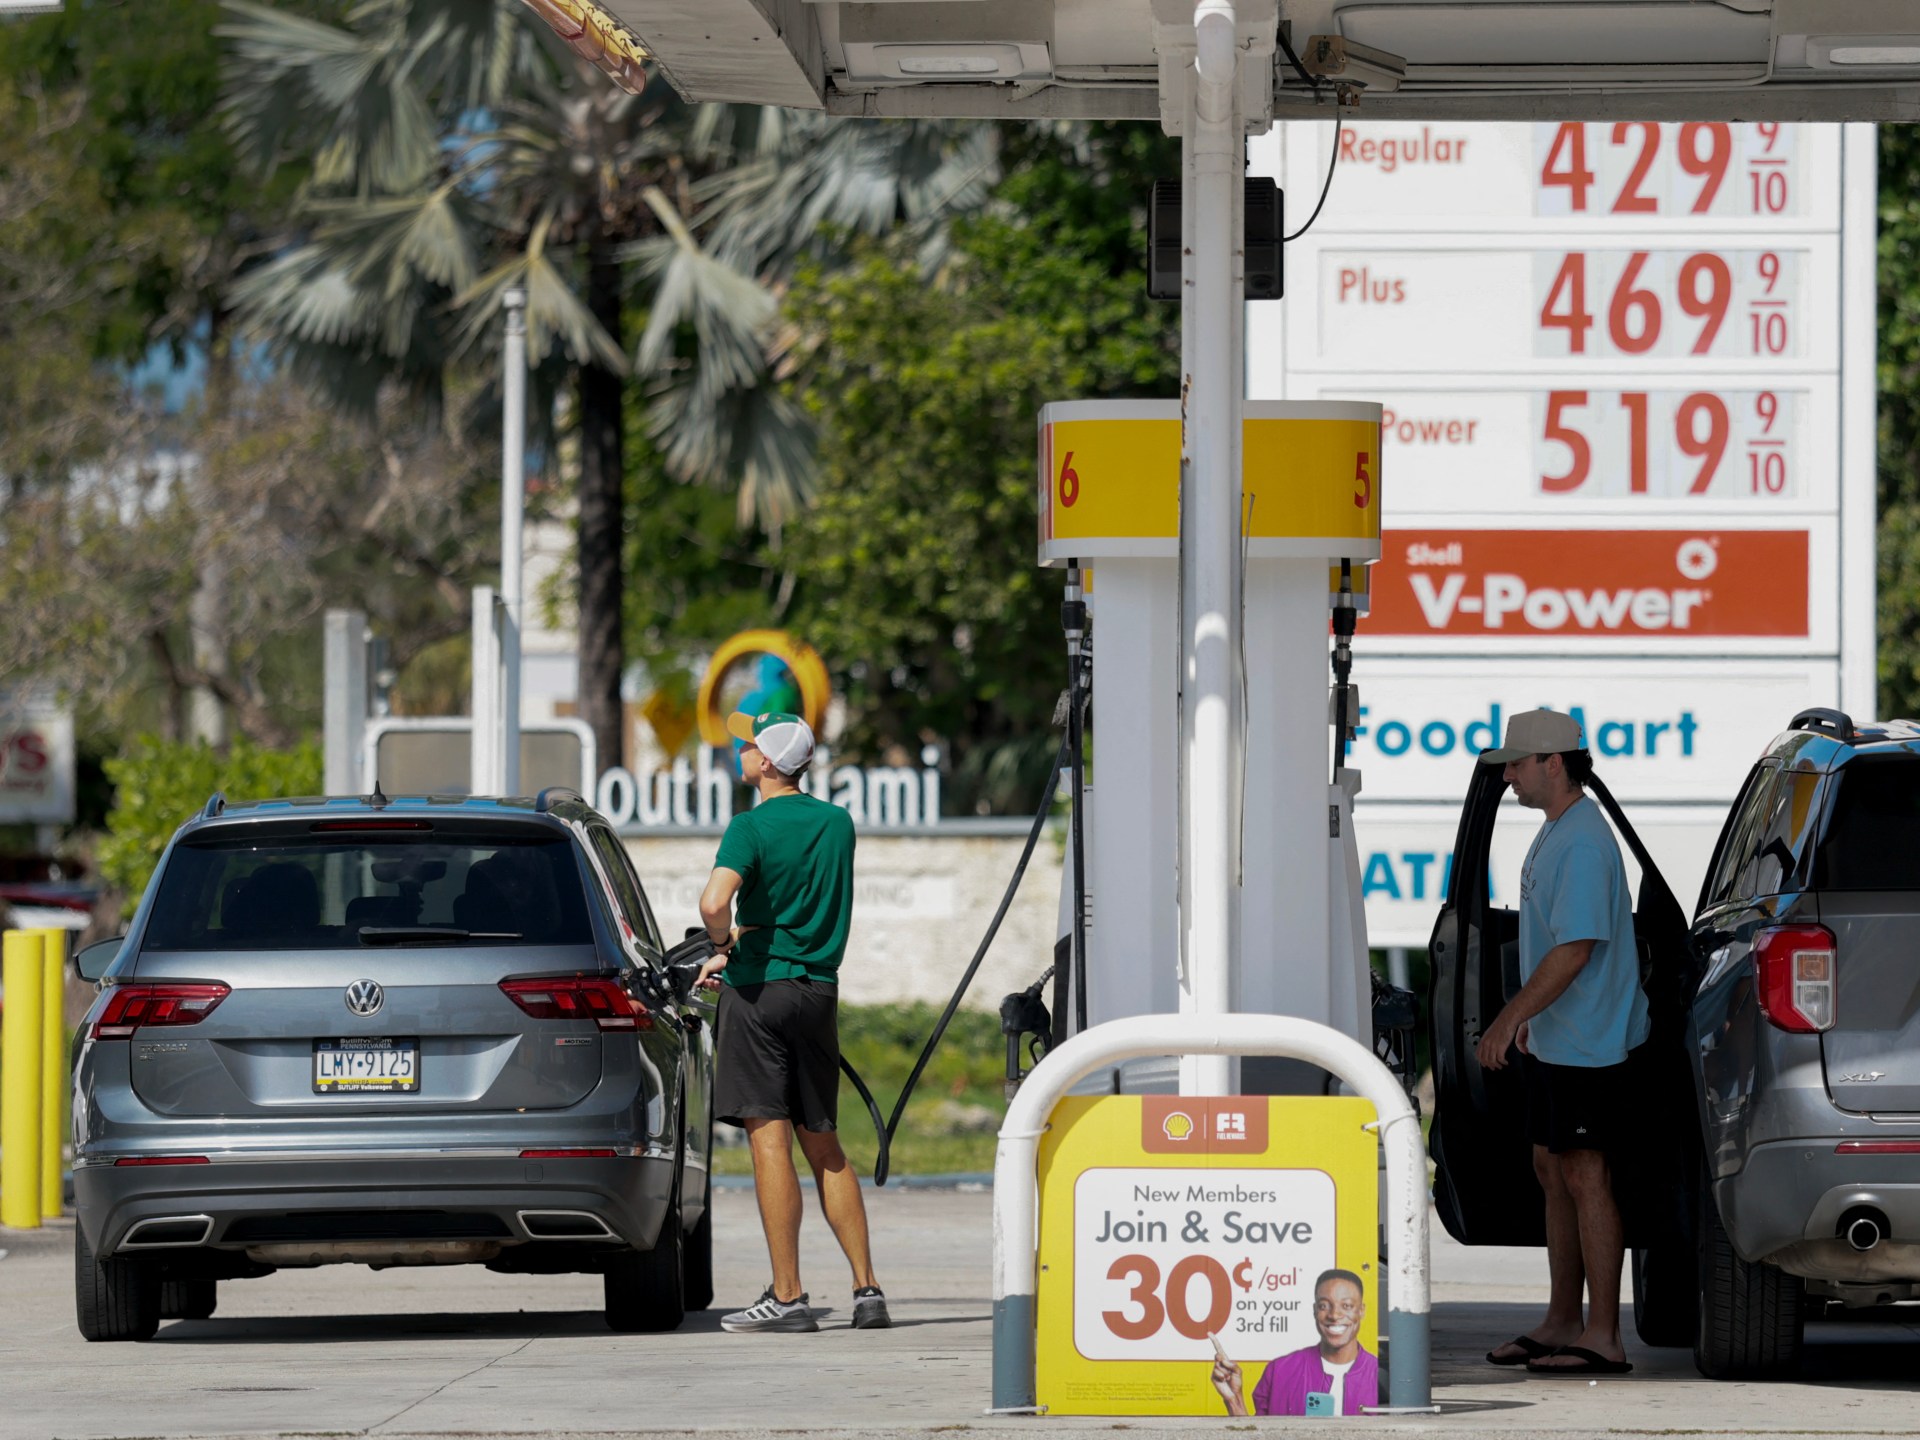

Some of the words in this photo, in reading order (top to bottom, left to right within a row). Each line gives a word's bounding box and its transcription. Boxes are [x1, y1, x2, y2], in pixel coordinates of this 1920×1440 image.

[1339, 127, 1466, 173] Regular
[1541, 122, 1732, 214] 429
[1750, 171, 1787, 213] 10
[1338, 267, 1406, 303] Plus
[1757, 252, 1780, 294] 9
[1540, 251, 1732, 355] 469
[1750, 313, 1787, 355] 10
[1755, 391, 1779, 434] 9
[1541, 390, 1730, 495] 519
[1059, 451, 1080, 508] 6
[1353, 451, 1371, 509] 5
[1748, 453, 1786, 495] 10
[1406, 543, 1463, 567] Shell
[1408, 572, 1702, 629] V-Power
[598, 743, 734, 827] outh
[758, 744, 941, 827] iami
[1839, 1071, 1885, 1083] XLT
[1133, 1185, 1180, 1202] New
[1186, 1184, 1277, 1203] Members
[1095, 1210, 1167, 1243] Join
[1180, 1210, 1210, 1244] &
[1222, 1210, 1313, 1244] Save
[1236, 1300, 1257, 1311] on
[1262, 1300, 1301, 1316] your
[1236, 1316, 1264, 1333] 3rd
[1269, 1315, 1288, 1333] fill
